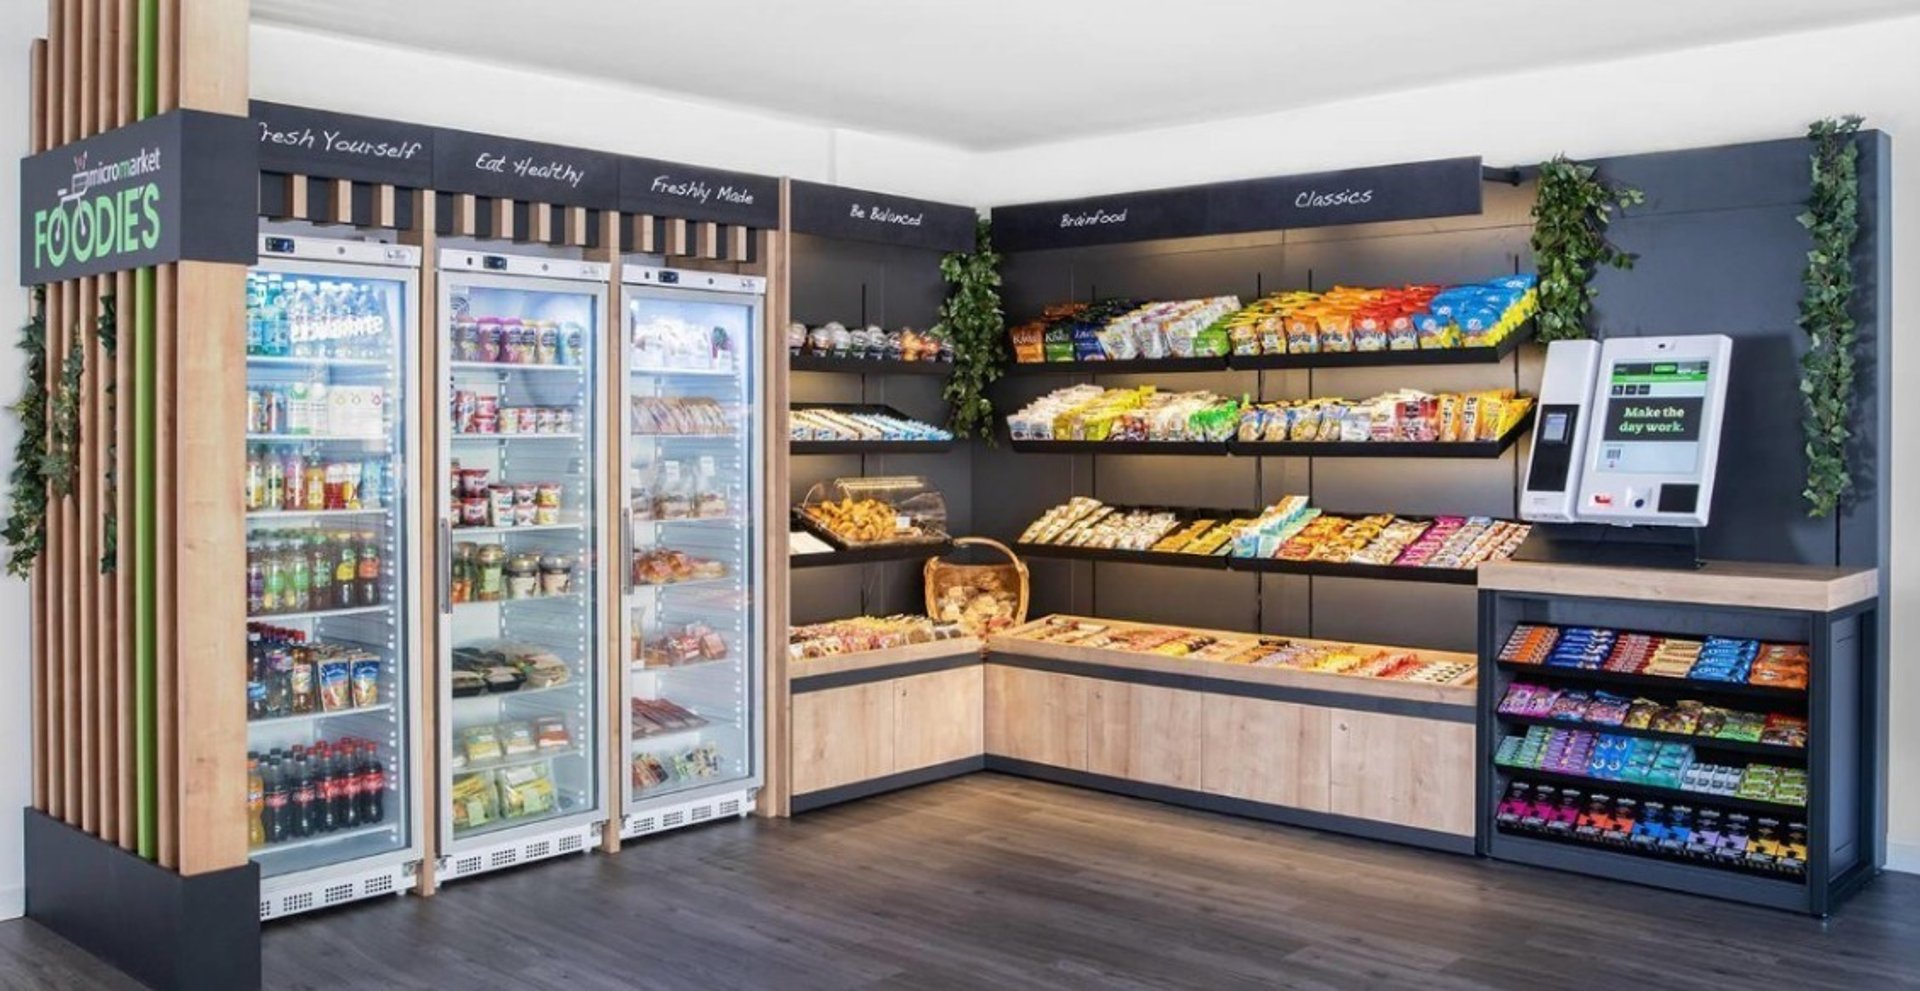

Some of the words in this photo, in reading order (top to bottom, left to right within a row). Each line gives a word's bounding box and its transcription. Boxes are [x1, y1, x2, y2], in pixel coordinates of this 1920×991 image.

[258, 121, 315, 149] resh
[323, 129, 422, 160] Yourself
[87, 146, 160, 188] micromarket
[475, 152, 506, 173] Eat
[512, 156, 584, 188] Healthy
[650, 174, 712, 205] Freshly
[716, 185, 754, 205] Made
[1294, 187, 1374, 209] Classics
[849, 203, 866, 218] Be
[870, 206, 924, 226] Balanced
[1060, 207, 1128, 229] Brainfood
[1623, 405, 1660, 418] Make
[1662, 405, 1685, 418] the
[1618, 420, 1643, 435] day
[1645, 420, 1685, 433] work.
